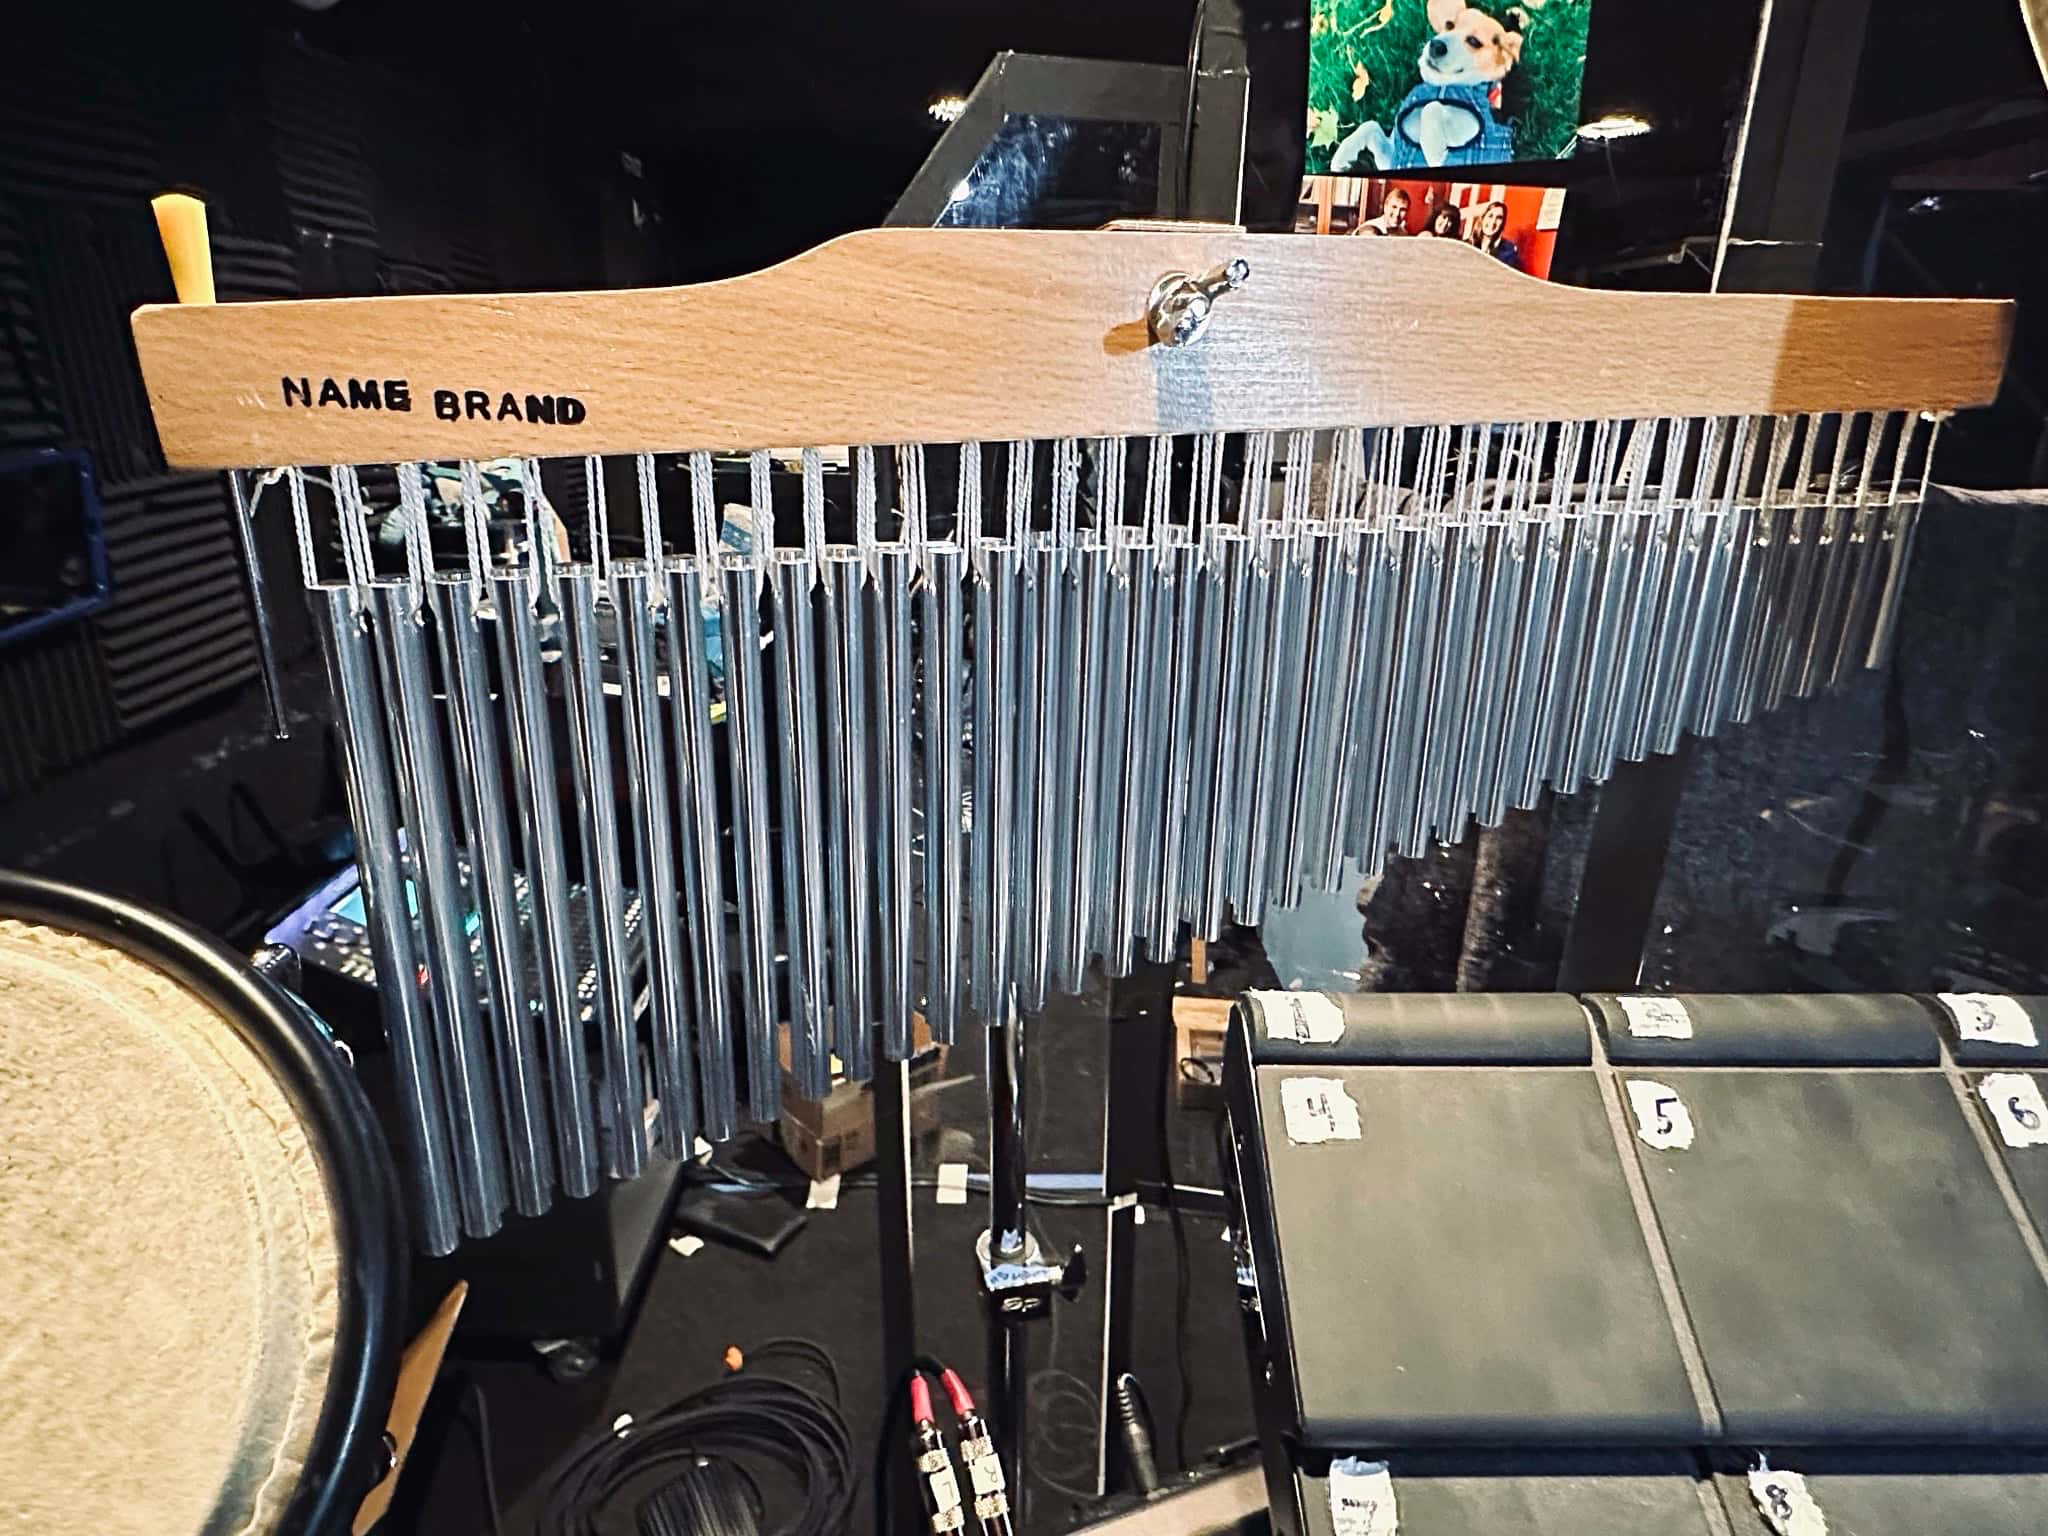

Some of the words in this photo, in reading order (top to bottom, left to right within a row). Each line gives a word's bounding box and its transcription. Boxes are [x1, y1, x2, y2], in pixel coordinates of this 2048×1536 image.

[281, 376, 412, 412] NAME
[434, 390, 587, 425] BRAND
[1306, 1093, 1336, 1132] 4
[1655, 1097, 1677, 1134] 5
[2008, 1096, 2041, 1130] 6
[1765, 1484, 1793, 1520] 8
